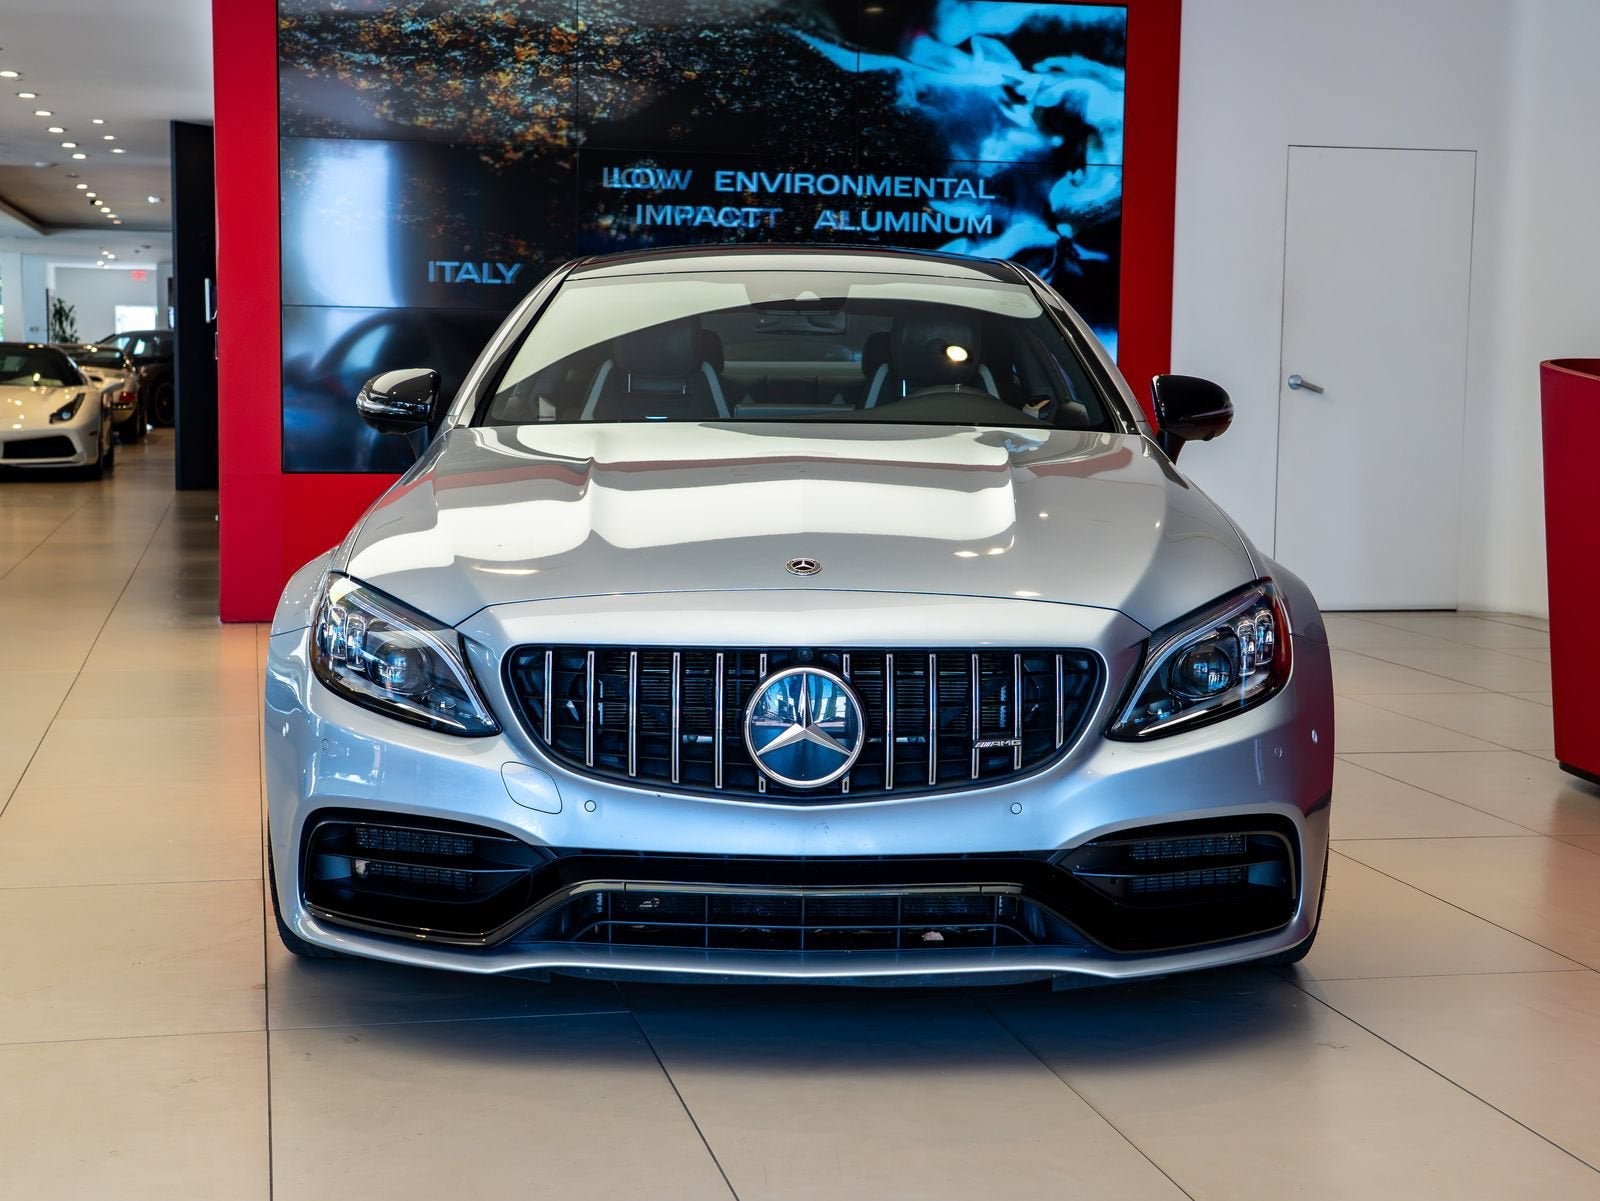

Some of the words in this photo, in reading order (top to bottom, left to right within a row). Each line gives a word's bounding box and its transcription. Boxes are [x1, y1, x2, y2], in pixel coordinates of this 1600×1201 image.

[602, 167, 693, 191] LOW
[715, 170, 996, 199] ENVIRONMENTAL
[636, 204, 783, 228] IMPACT
[813, 209, 993, 234] ALUMINUM
[428, 260, 521, 285] ITALY
[989, 740, 1022, 748] AMG
